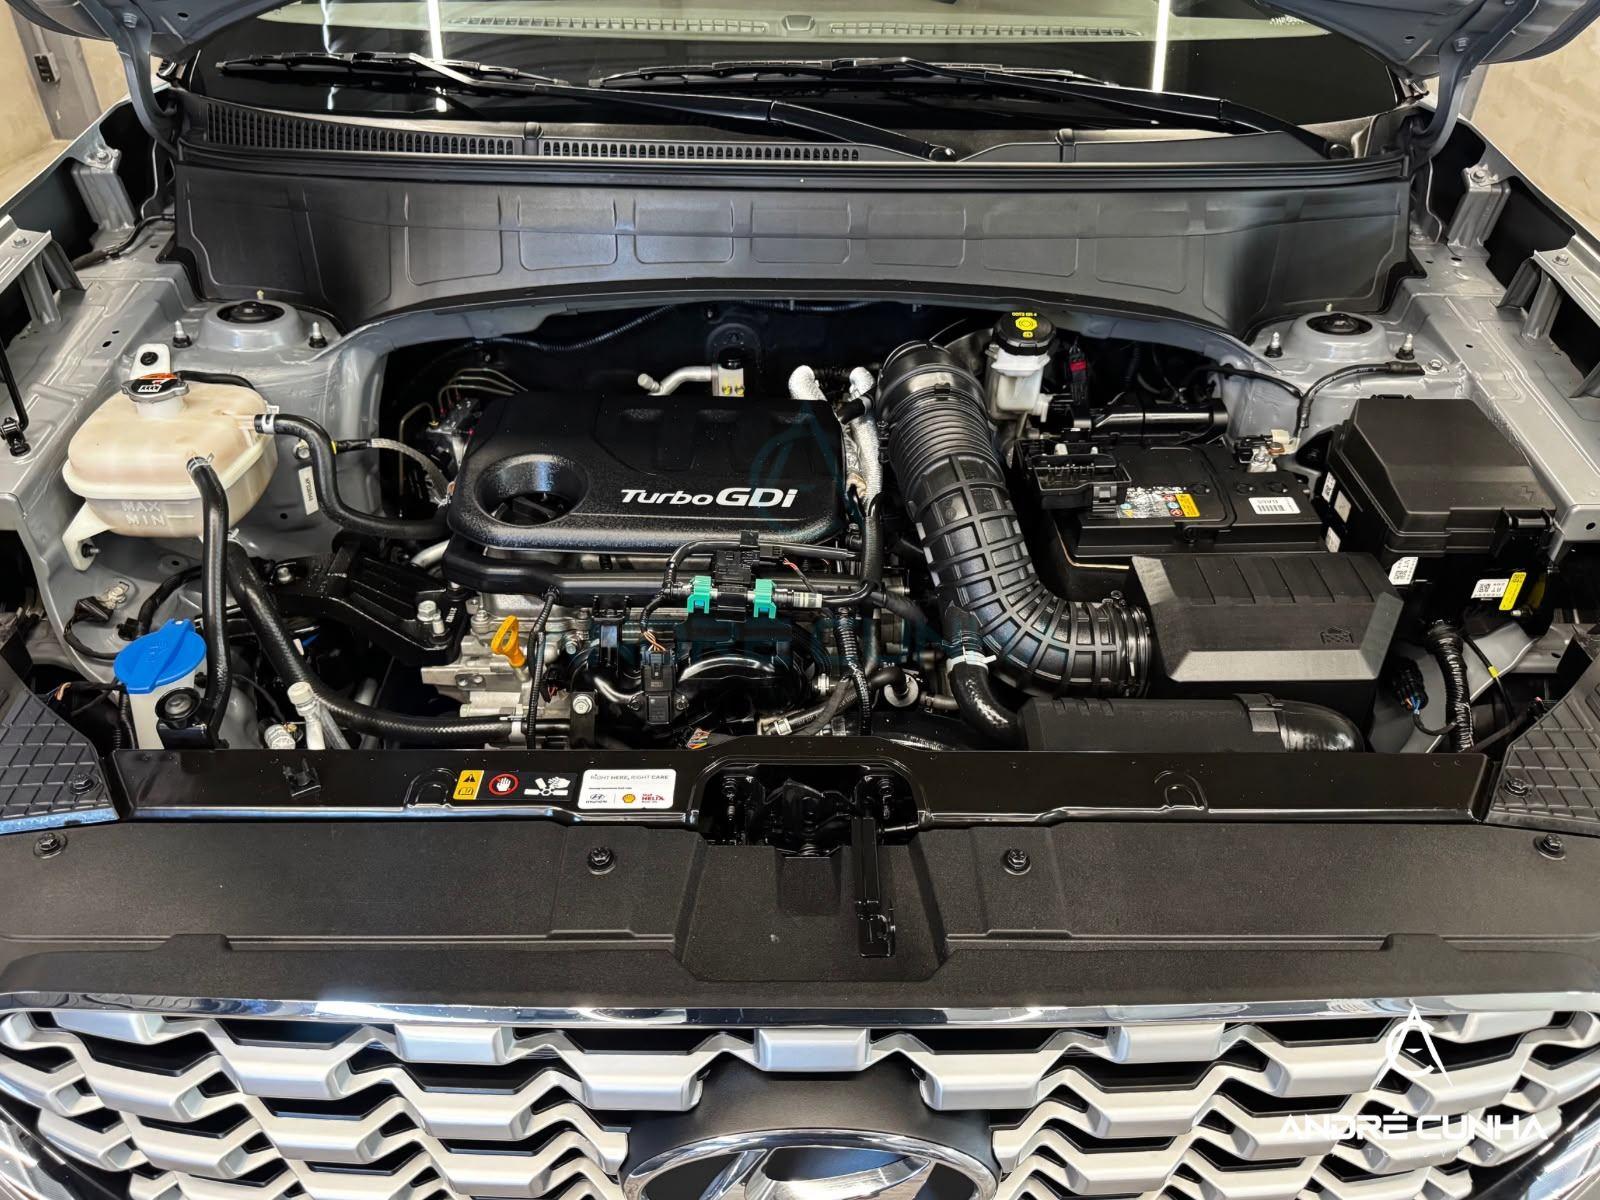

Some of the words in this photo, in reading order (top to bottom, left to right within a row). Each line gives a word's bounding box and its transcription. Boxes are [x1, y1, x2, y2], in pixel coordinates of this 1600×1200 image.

[620, 489, 714, 506] Turbo
[715, 487, 799, 508] GDi
[121, 501, 161, 512] MAX
[125, 514, 166, 526] MIN
